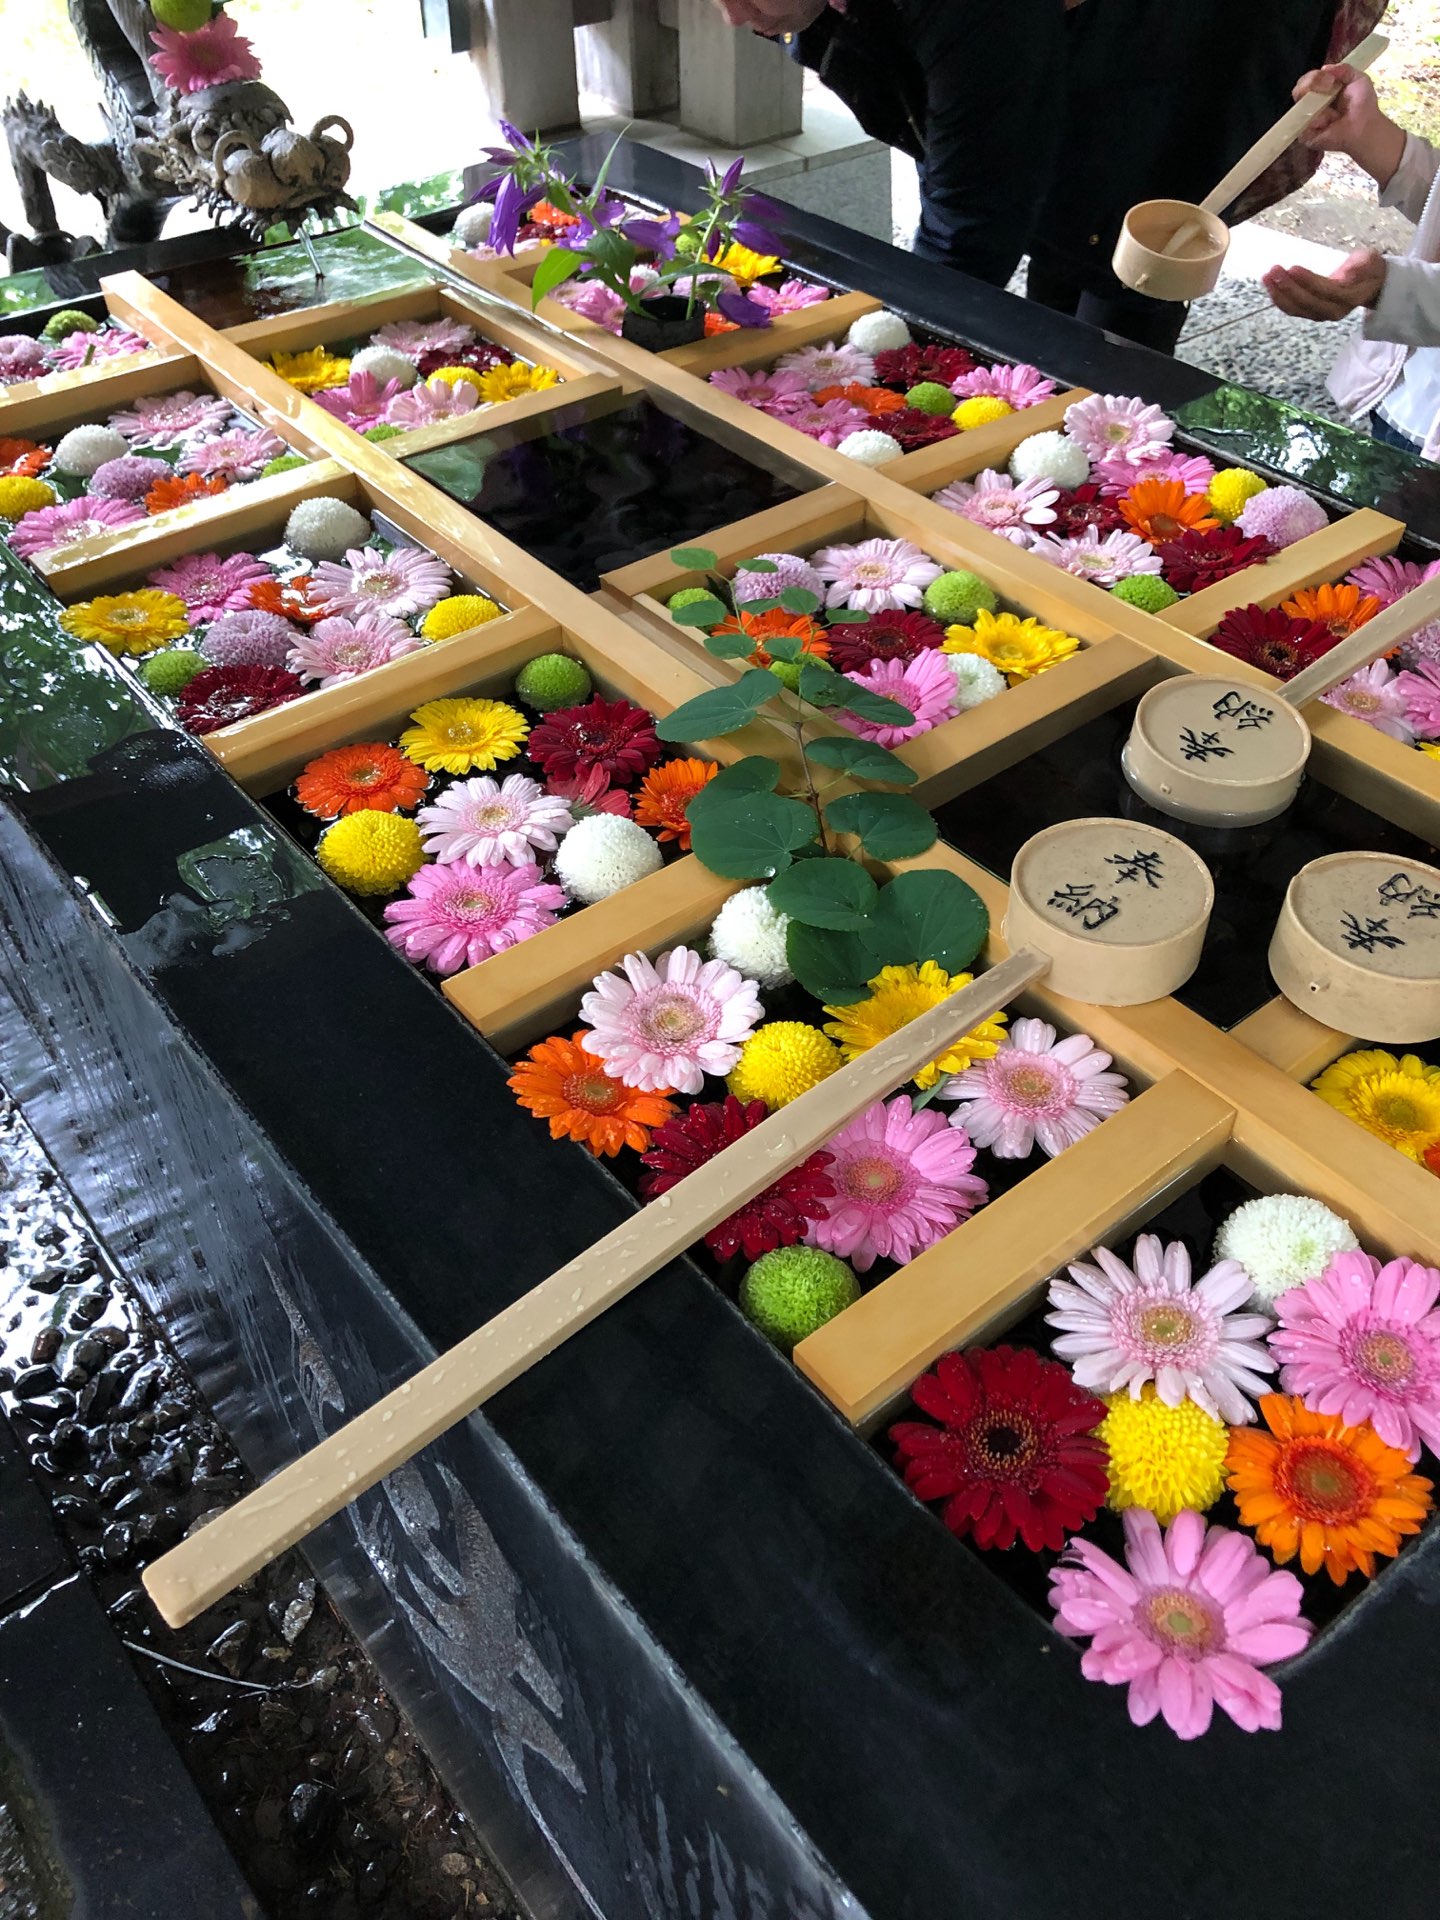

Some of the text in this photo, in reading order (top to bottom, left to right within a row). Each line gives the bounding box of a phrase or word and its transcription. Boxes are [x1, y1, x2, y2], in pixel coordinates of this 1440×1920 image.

[1179, 690, 1274, 763] 奉納
[1046, 849, 1164, 930] 奉納
[1340, 872, 1440, 954] 奉納
